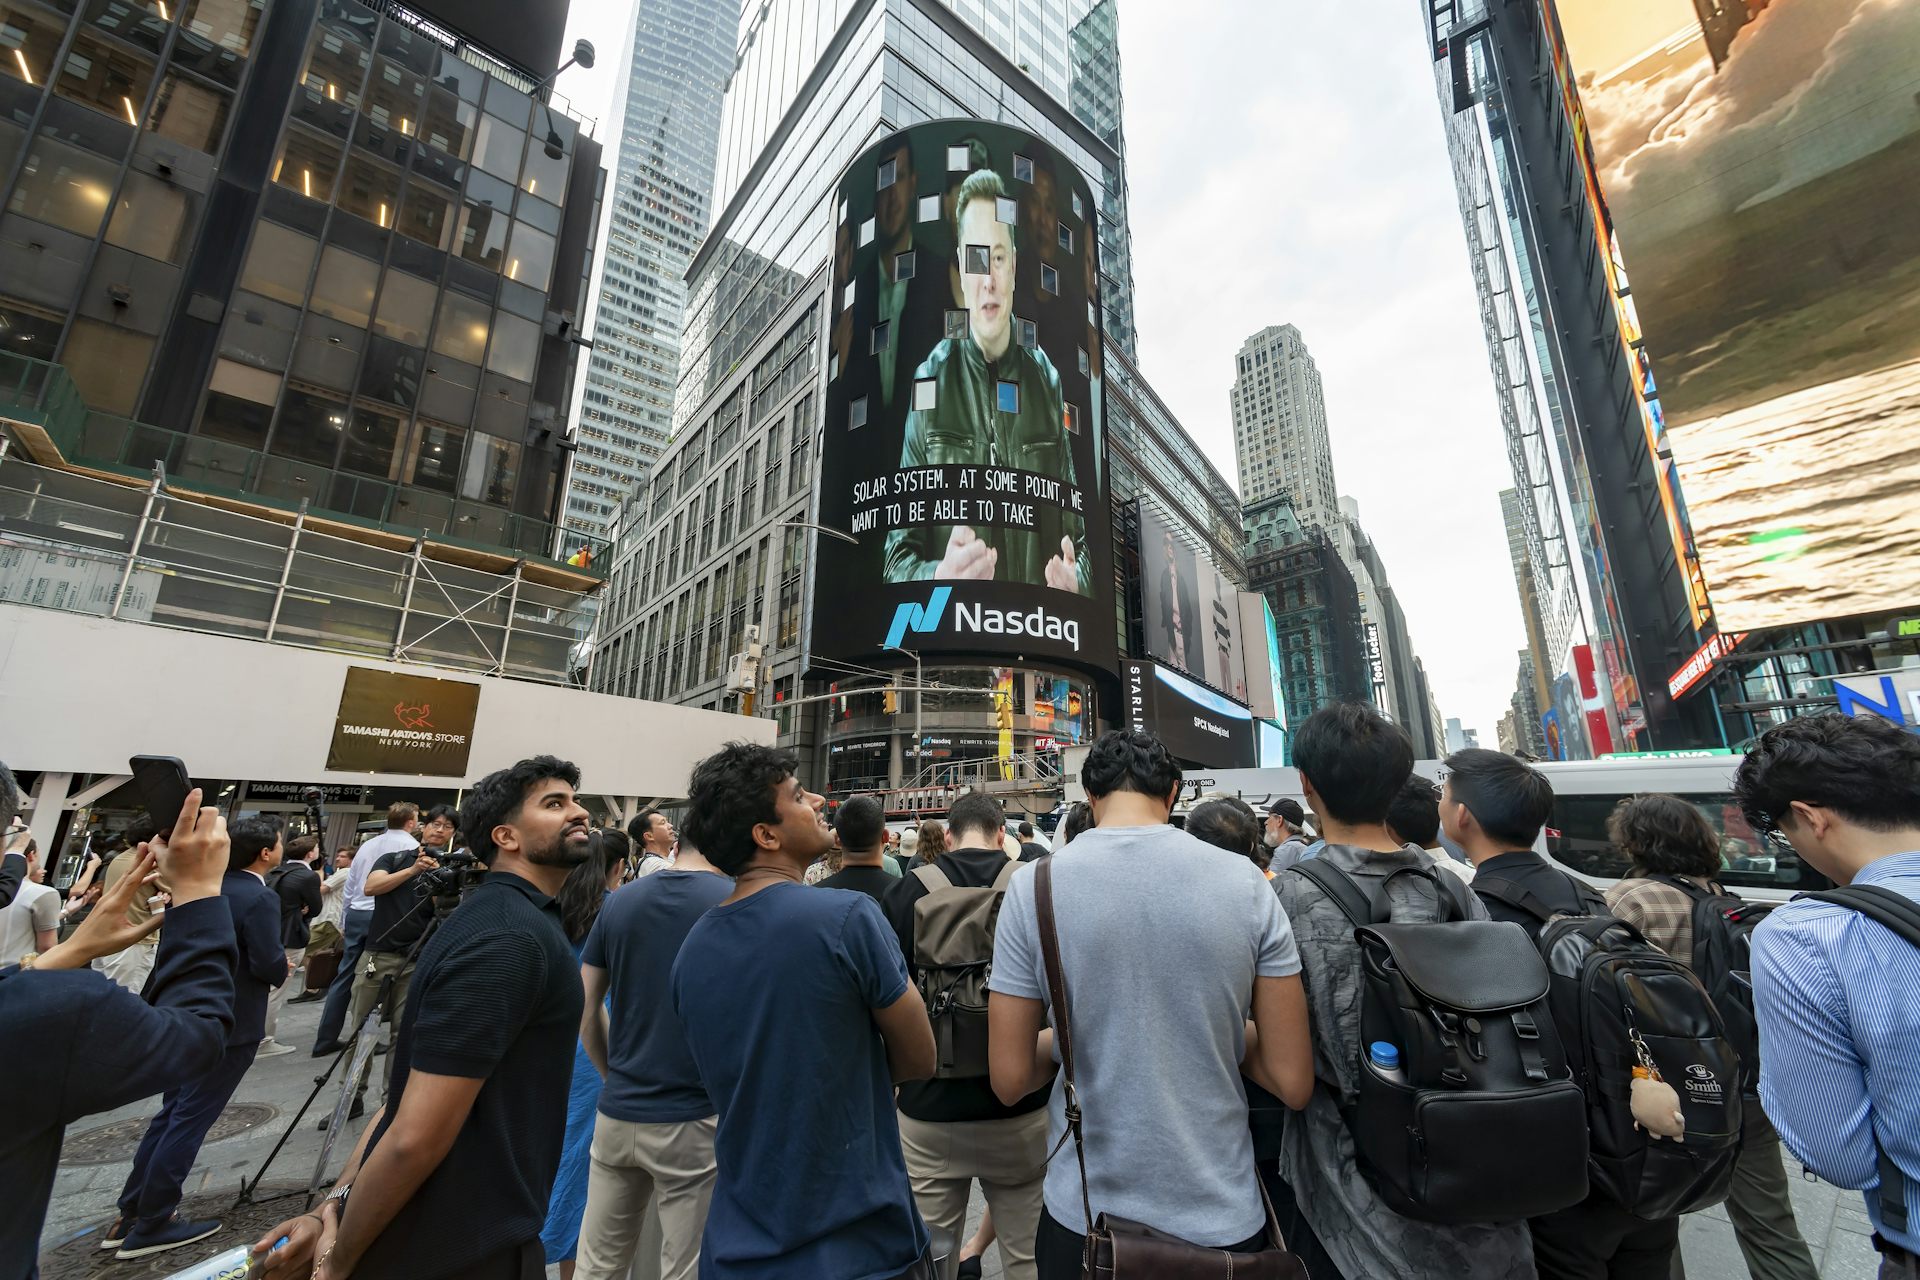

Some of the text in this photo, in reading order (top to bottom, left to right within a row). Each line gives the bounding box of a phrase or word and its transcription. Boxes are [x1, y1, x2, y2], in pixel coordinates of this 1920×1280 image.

[853, 468, 1083, 511] SOLAR SYSTEM. AT SOME POINT, WE
[851, 499, 1034, 534] WANT TO BE ABLE TO TAKE
[955, 602, 1080, 652] Nasdaq
[1367, 625, 1384, 683] Foot Locker
[1193, 716, 1208, 731] SPCX
[342, 724, 390, 737] TAMASHII
[434, 733, 466, 744] STORE
[379, 738, 432, 749] NEW YORK
[931, 738, 951, 746] Nasdaq
[1685, 1079, 1722, 1093] Smith
